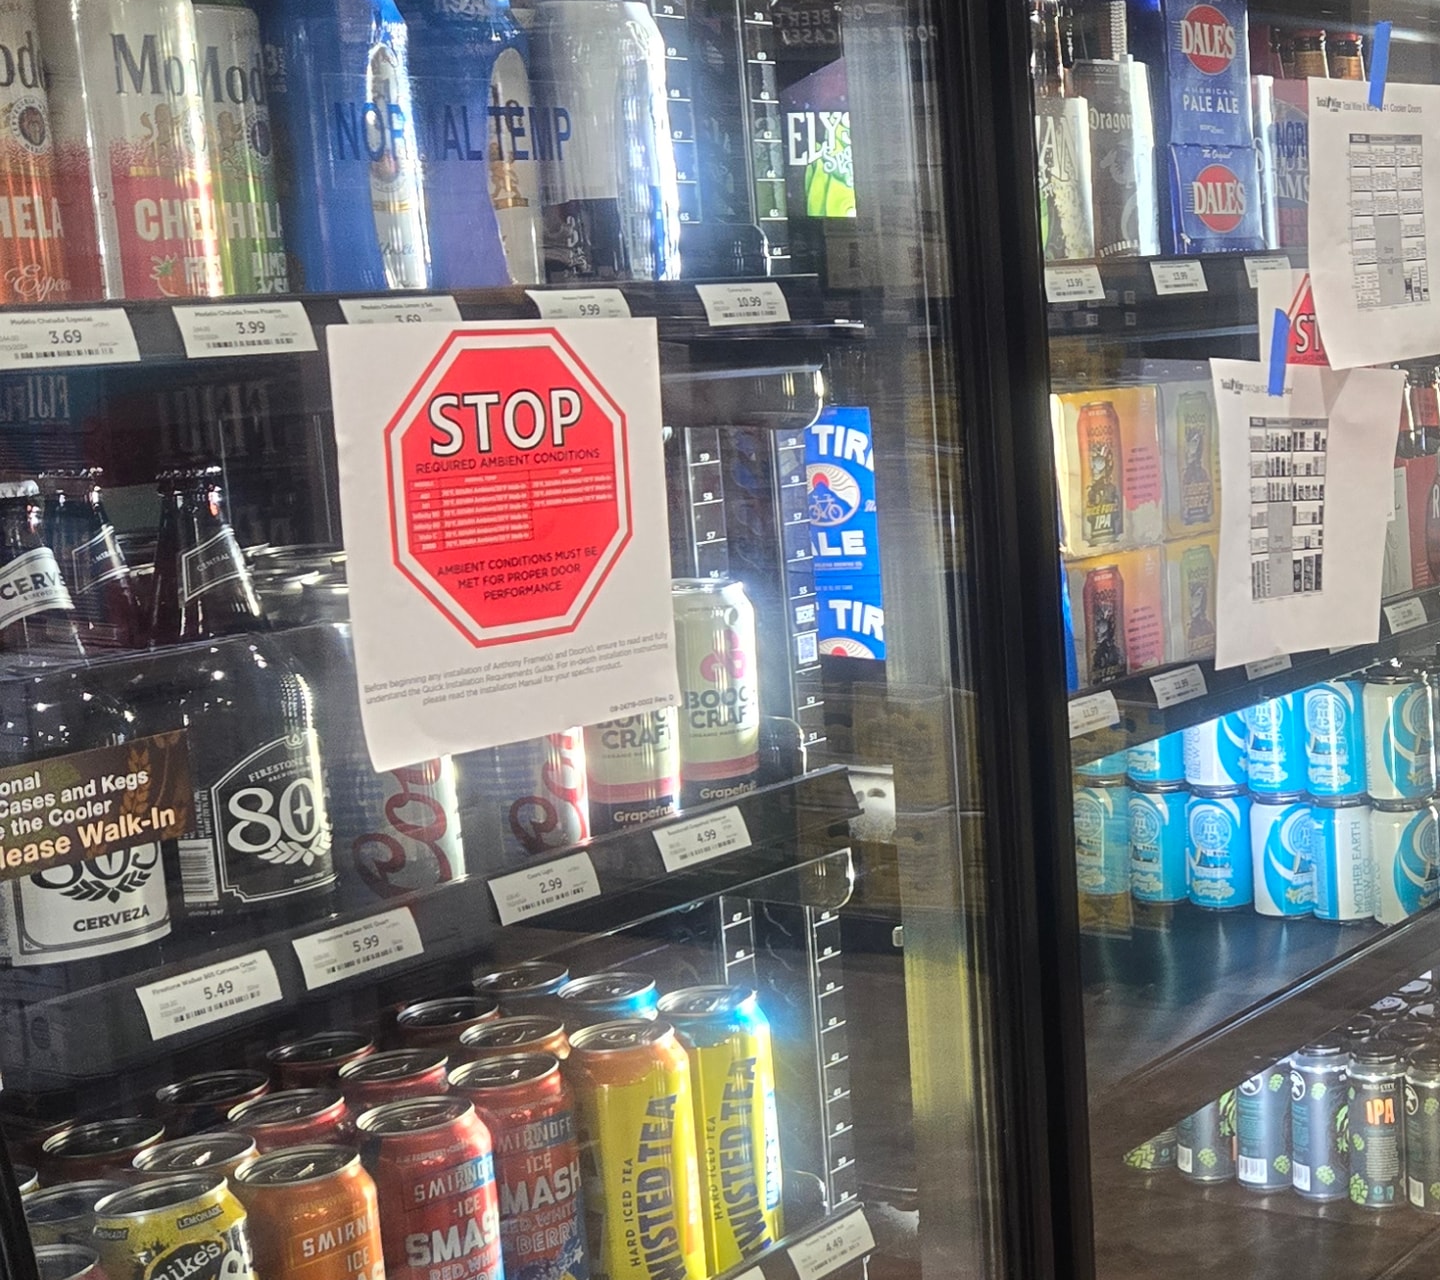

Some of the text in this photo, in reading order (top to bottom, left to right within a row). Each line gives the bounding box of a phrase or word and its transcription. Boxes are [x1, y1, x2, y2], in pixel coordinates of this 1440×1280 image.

[1181, 19, 1236, 60] DALE'S
[1183, 94, 1239, 114] PALE ALE
[333, 102, 483, 163] NORAL
[1192, 178, 1246, 216] DALE'S
[579, 304, 600, 316] 9.99
[737, 296, 761, 308] 10.99
[51, 329, 82, 345] 3.69
[238, 321, 266, 335] 3.99
[428, 388, 583, 457] STOP
[416, 448, 600, 473] REQUIRED AMBIENT CONDITIONS
[437, 546, 597, 576] AMBIENT CONDITIONS MUST BE
[458, 563, 581, 589] MET FOR PROPER DOOR
[484, 581, 562, 600] PERFORMANCE
[61, 779, 96, 804] and
[101, 770, 149, 794] Kegs
[11, 799, 112, 835] the Cooler
[77, 806, 175, 850] Walk-In
[697, 829, 716, 843] 4.99
[539, 877, 562, 894] 2.99
[73, 905, 150, 932] CERVEZA
[353, 935, 380, 952] 5.99
[203, 980, 233, 1000] 5.49
[720, 1057, 756, 1121] TEA
[1366, 1098, 1395, 1125] IPA
[638, 1094, 677, 1163] TEA
[706, 1116, 716, 1140] TEA
[622, 1158, 641, 1268] HARD ICED TEA
[709, 1183, 723, 1221] HARD
[177, 1206, 224, 1228] LEMONADE
[825, 1236, 844, 1253] 4.49
[347, 1247, 370, 1273] ICE
